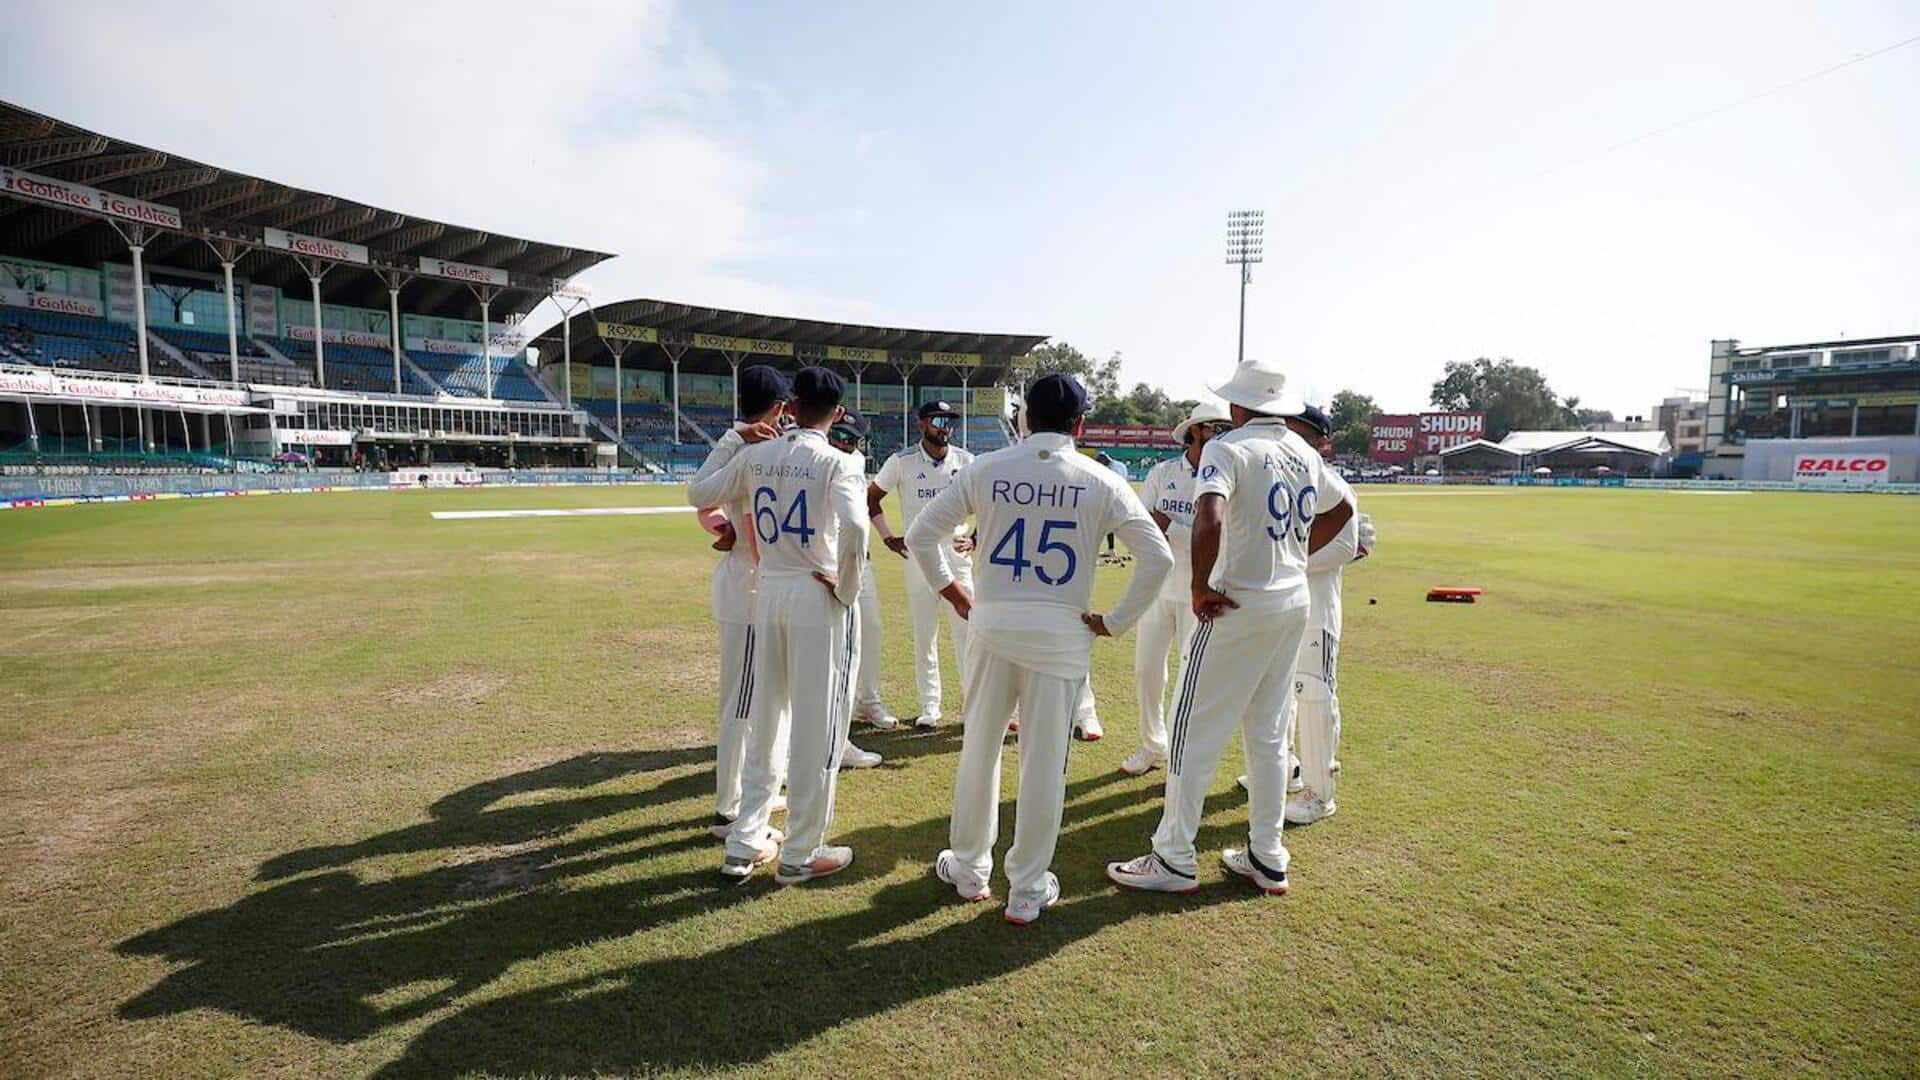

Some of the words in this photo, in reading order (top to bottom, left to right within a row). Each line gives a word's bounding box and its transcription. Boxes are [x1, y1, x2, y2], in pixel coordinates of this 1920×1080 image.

[16, 177, 92, 206] Goldiee
[111, 199, 177, 226] Goldiee
[296, 239, 348, 258] Goldiee
[38, 296, 96, 314] Goldiee
[607, 324, 648, 340] ROXX
[700, 335, 736, 350] ROXX
[752, 341, 786, 354] ROXX
[840, 347, 875, 360] ROXX
[1372, 426, 1414, 439] SHUDH
[1420, 415, 1483, 433] SHUDH
[1377, 439, 1407, 452] PLUS
[1797, 459, 1887, 472] RALCO
[992, 480, 1086, 509] ROHIT
[755, 487, 815, 547] 64
[1267, 481, 1318, 542] 99
[990, 518, 1077, 586] 45
